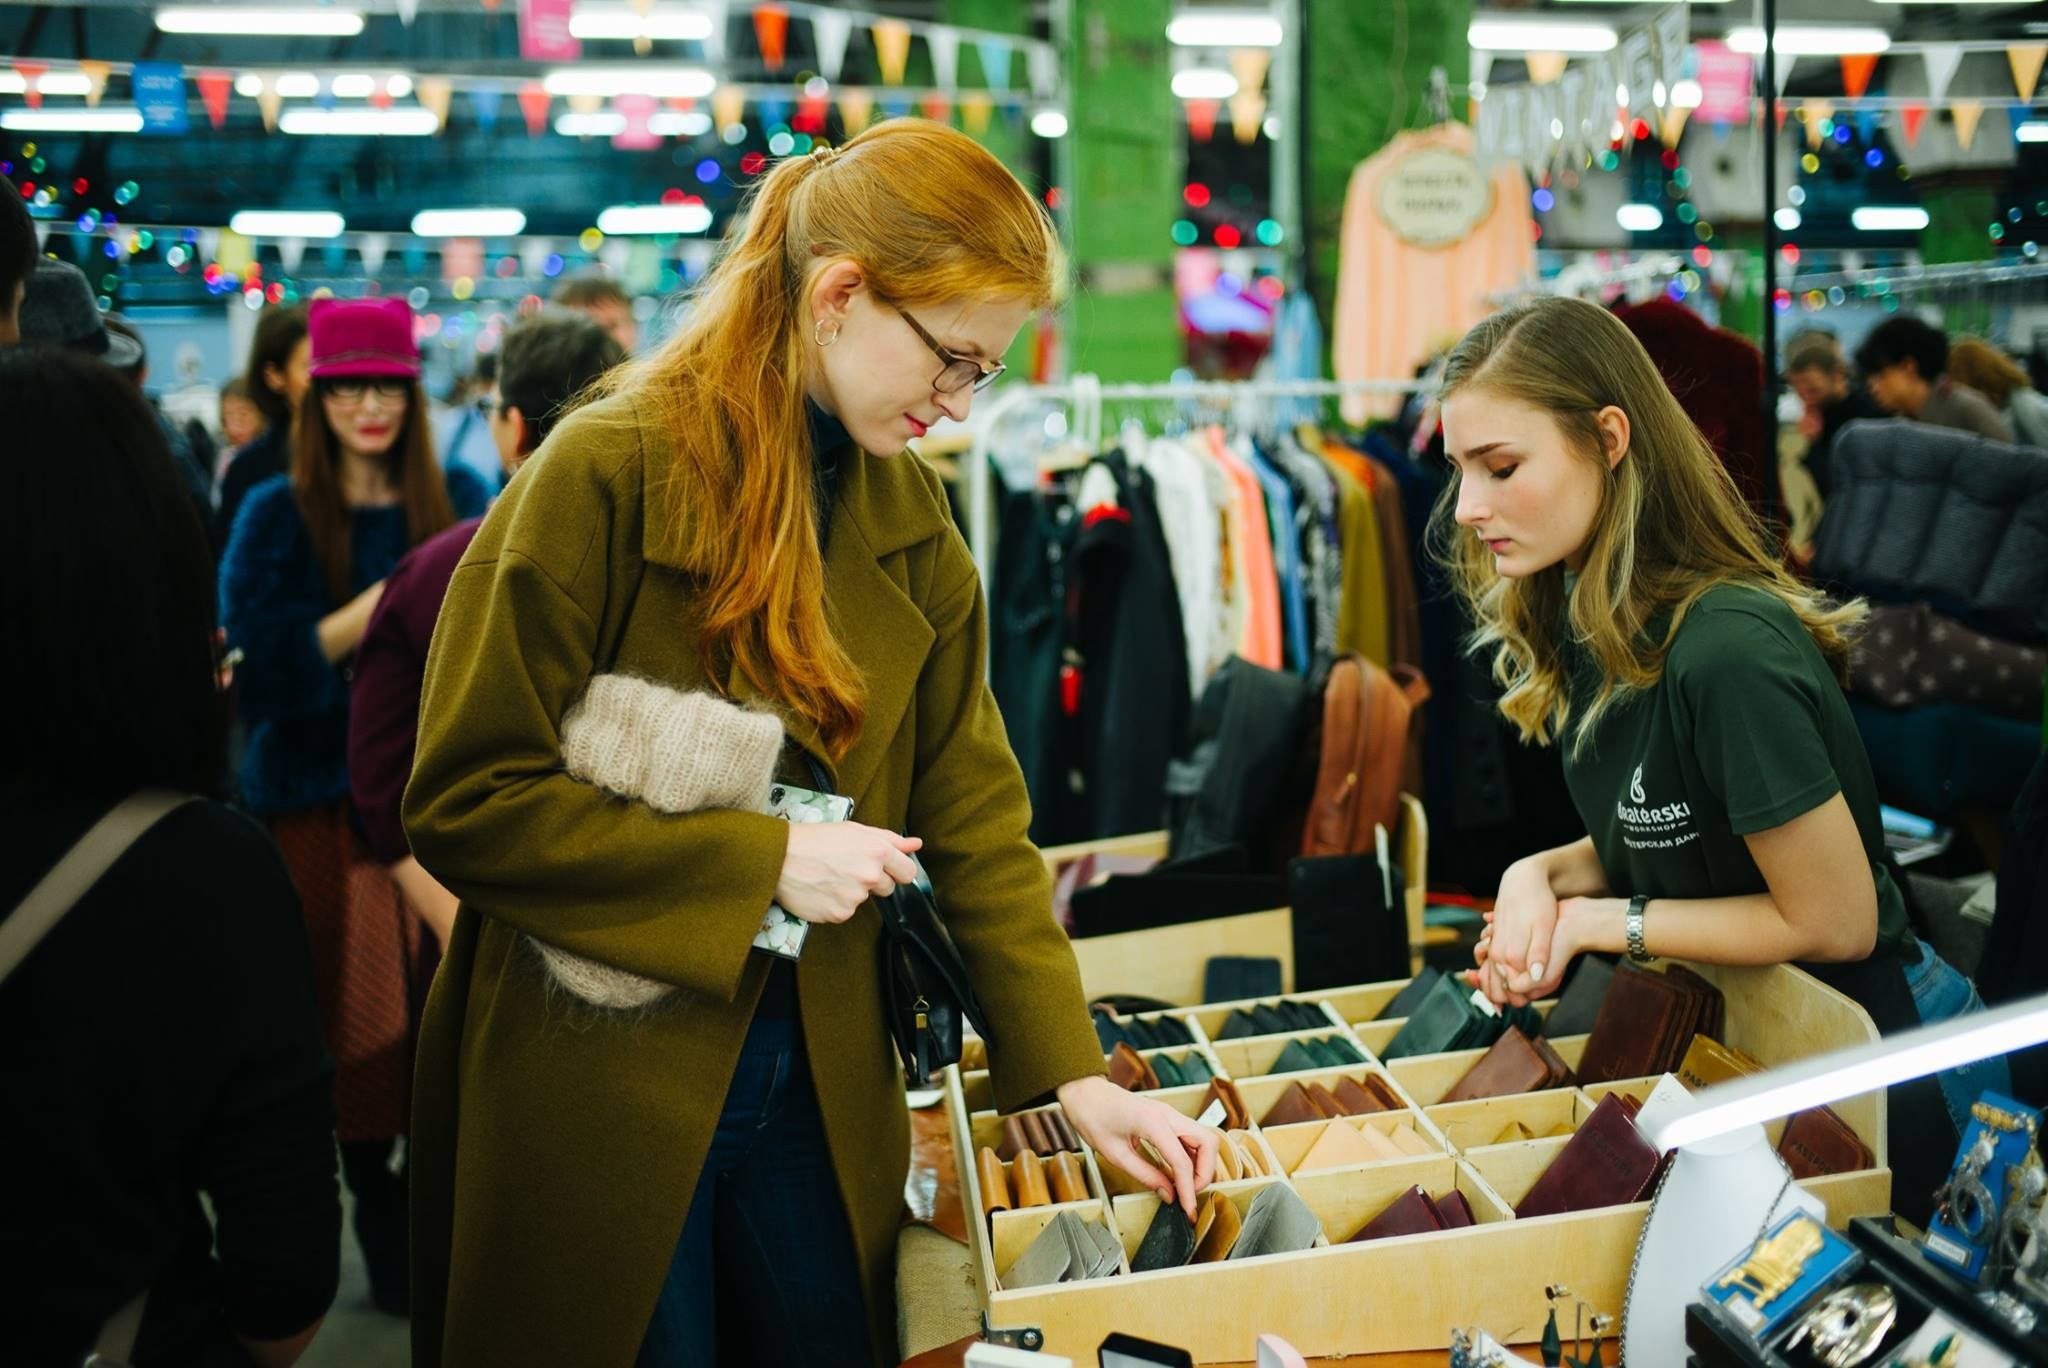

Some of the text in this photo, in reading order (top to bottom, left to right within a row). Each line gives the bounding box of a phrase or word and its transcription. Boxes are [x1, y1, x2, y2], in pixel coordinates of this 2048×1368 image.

[1629, 823, 1677, 833] WORKSHOP
[1623, 836, 1674, 849] ТЕРСКАЯ
[1683, 1070, 1709, 1088] PASS
[1790, 1138, 1834, 1176] PASSPOR
